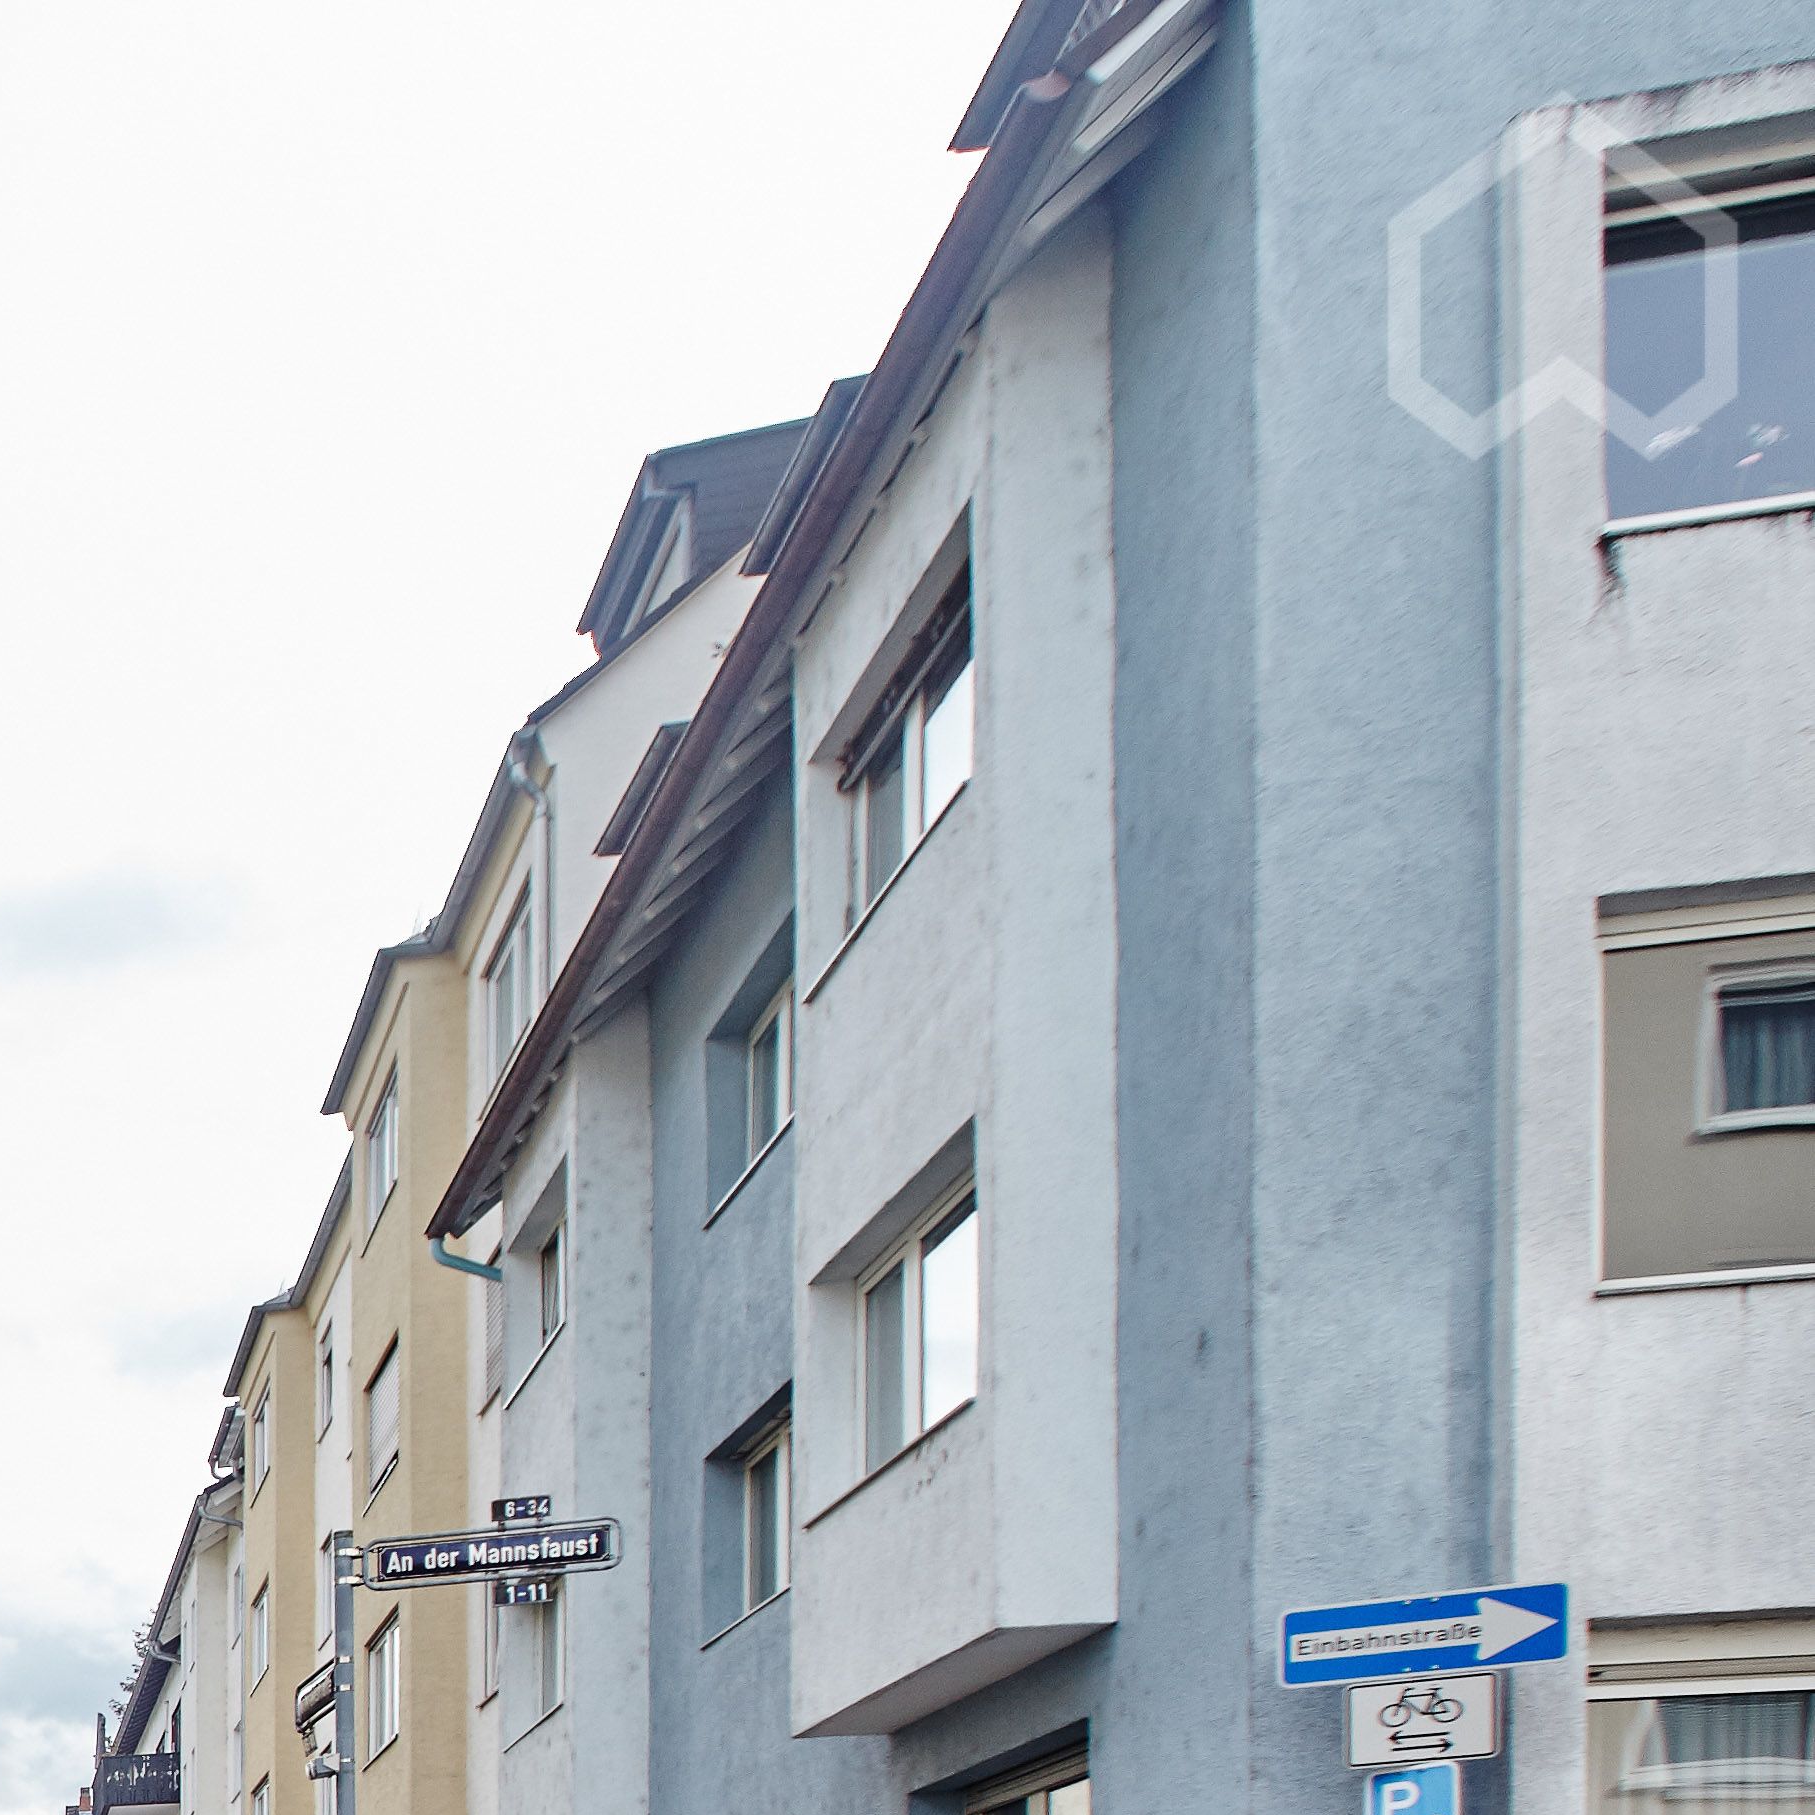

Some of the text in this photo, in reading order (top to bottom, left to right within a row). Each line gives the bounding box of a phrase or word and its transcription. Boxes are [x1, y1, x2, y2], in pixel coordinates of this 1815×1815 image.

[504, 1499, 550, 1518] 6-34
[386, 1533, 599, 1574] An der Mannsfaust
[506, 1583, 548, 1604] 1-11
[1296, 1622, 1483, 1657] Einbahnstraße
